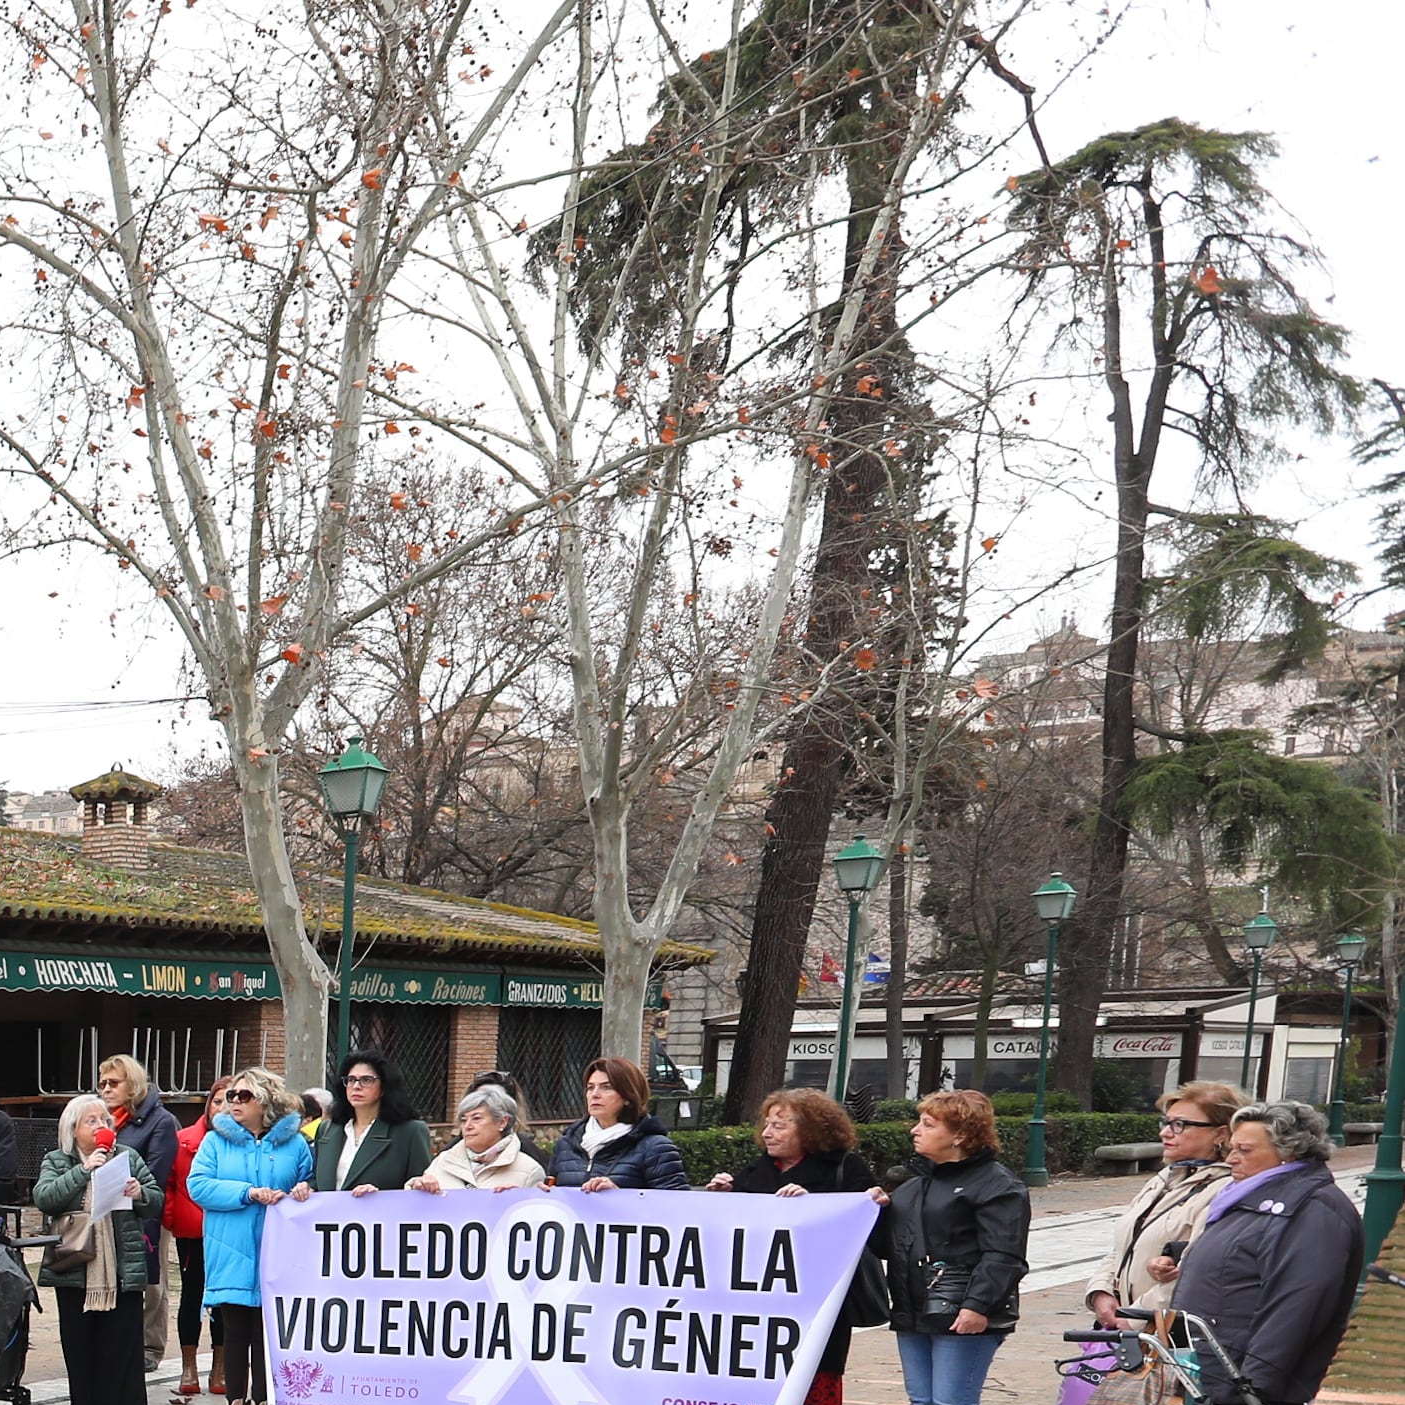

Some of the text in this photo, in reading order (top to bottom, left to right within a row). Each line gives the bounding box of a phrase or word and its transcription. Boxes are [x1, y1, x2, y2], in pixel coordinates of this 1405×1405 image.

[34, 958, 119, 988] HORCHATA
[141, 964, 186, 992] LIMON
[209, 971, 231, 994] San
[231, 970, 266, 996] Miguel
[431, 976, 487, 1000] Raciones
[507, 980, 567, 1003] GRANIZADOS
[314, 1220, 799, 1294] TOLEDO CONTRA LA
[274, 1296, 513, 1361] VIOLENCIA
[531, 1302, 593, 1364] DE
[350, 1384, 419, 1399] TOLEDO
[351, 1376, 406, 1384] AYUNTAMIENTO
